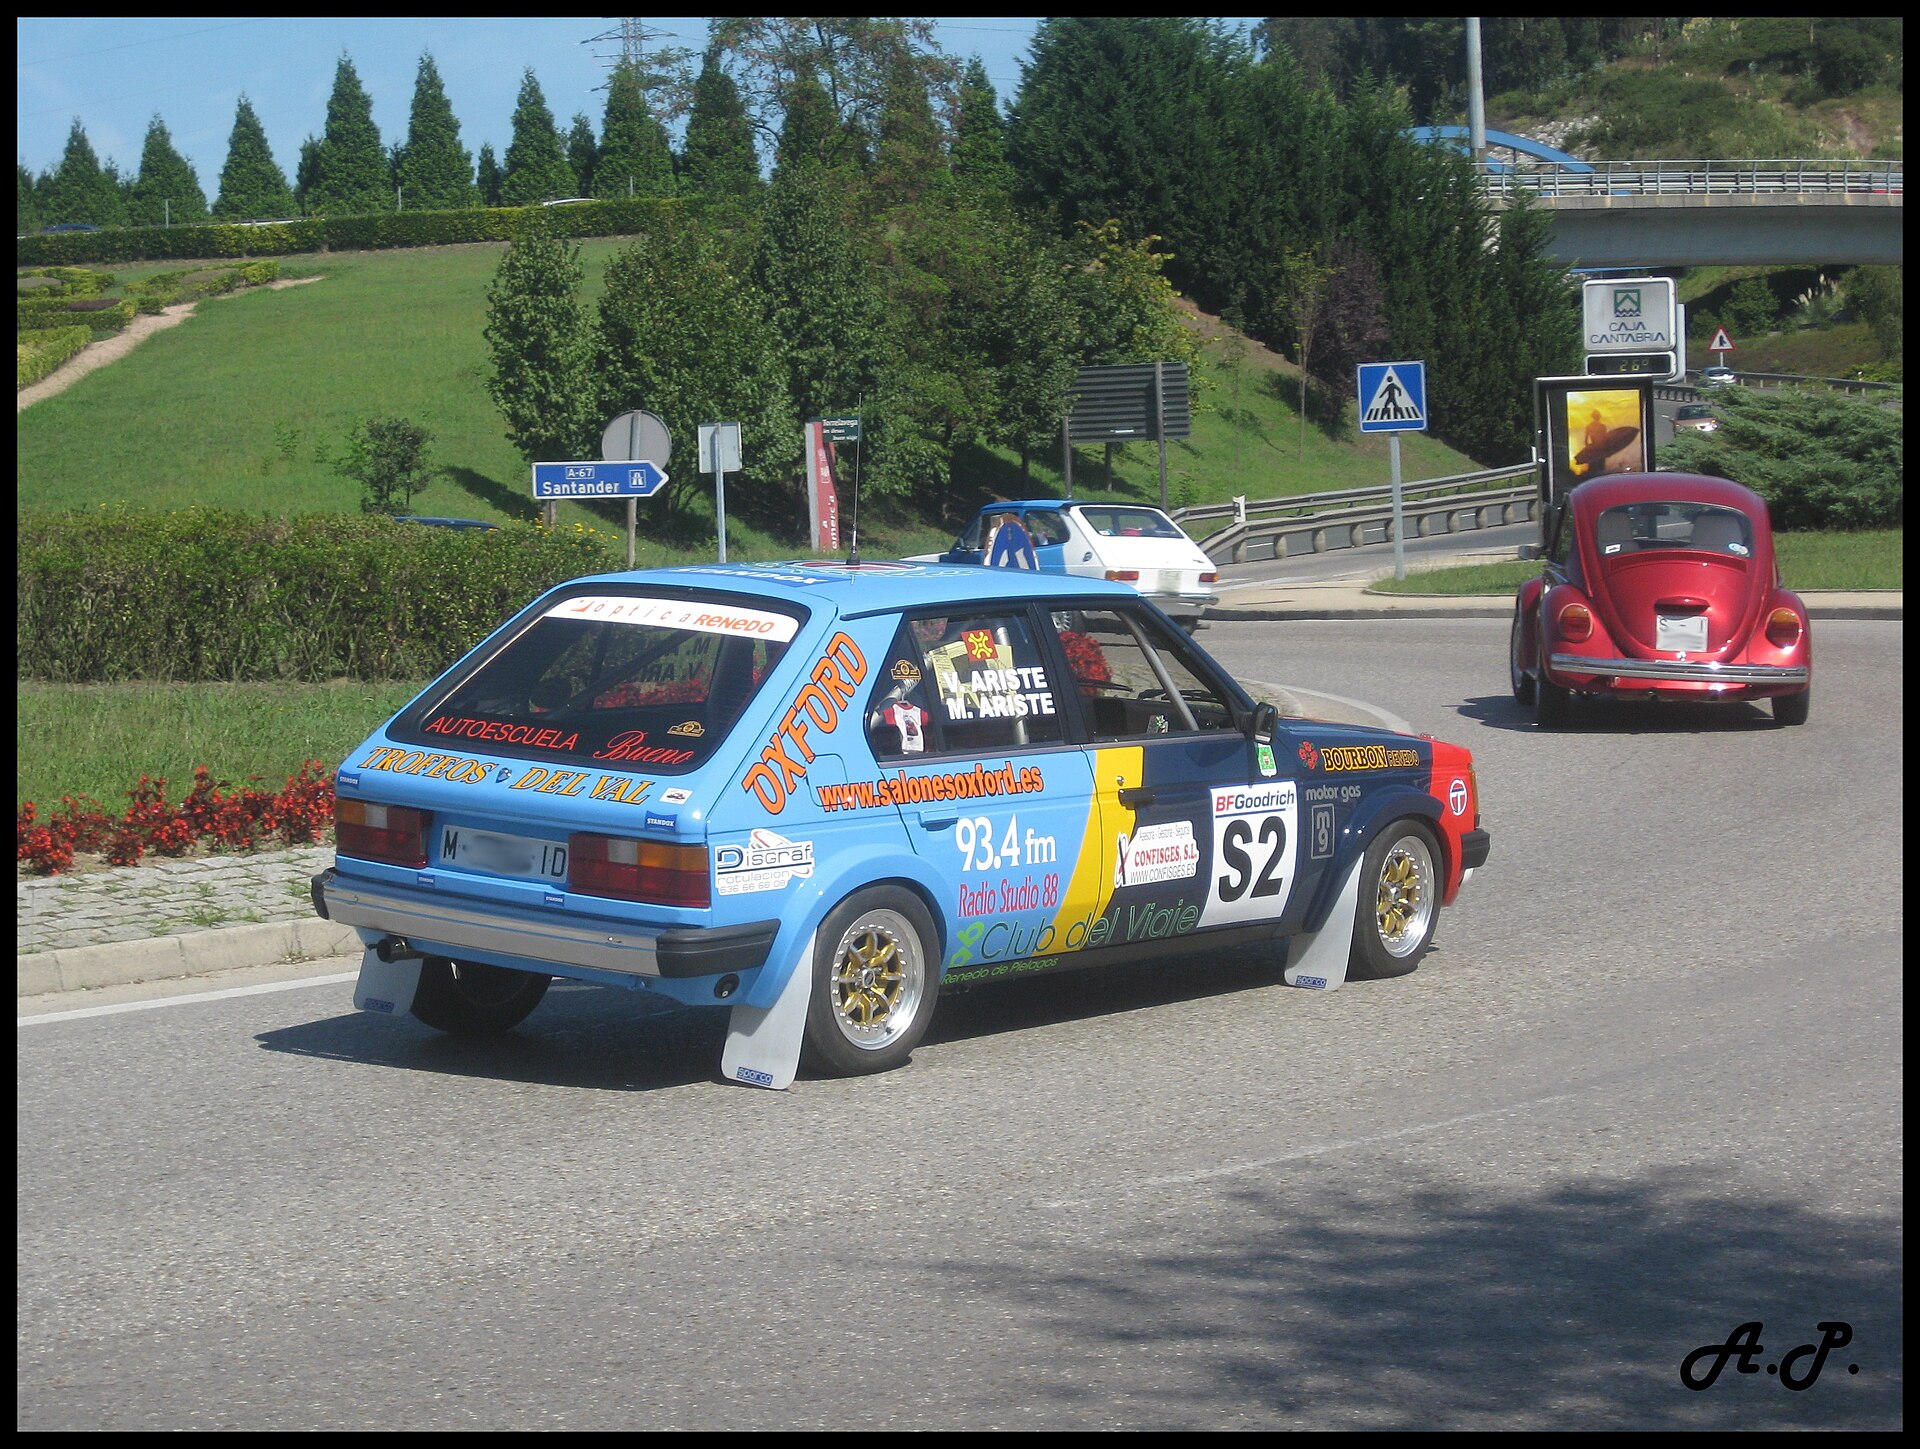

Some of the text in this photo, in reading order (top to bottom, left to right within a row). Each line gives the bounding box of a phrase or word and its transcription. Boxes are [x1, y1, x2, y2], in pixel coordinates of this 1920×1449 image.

[1590, 332, 1665, 344] CANTABRIA
[1609, 321, 1646, 332] CAJA
[568, 468, 593, 477] A-67
[542, 480, 620, 494] Santander
[942, 671, 965, 693] V.
[972, 666, 1048, 693] ARISTE
[946, 692, 1056, 720] M. ARISTE
[741, 631, 868, 816] OXFORD
[425, 716, 695, 765] AUTOESCUELA Bueno
[1320, 745, 1388, 772] BOURBON
[357, 746, 656, 806] TROFEOS DEL VAL
[816, 760, 1044, 813] www.salonesoxford.es
[1216, 790, 1295, 813] BFGoodrich
[1306, 784, 1362, 803] motor gas
[646, 818, 676, 828] STANDOX
[442, 830, 458, 860] M
[956, 812, 1057, 872] 93.4 fm
[1134, 843, 1198, 868] CONFISGES, S.L.
[1218, 816, 1287, 902] S2
[1130, 863, 1196, 884] WWW.CONFISGES.ES
[957, 872, 1059, 918] Radio Studio 88
[980, 898, 1200, 961] Club del Viaje
[941, 968, 990, 984] Renedo
[992, 964, 1010, 976] de
[738, 1068, 772, 1083] sparco
